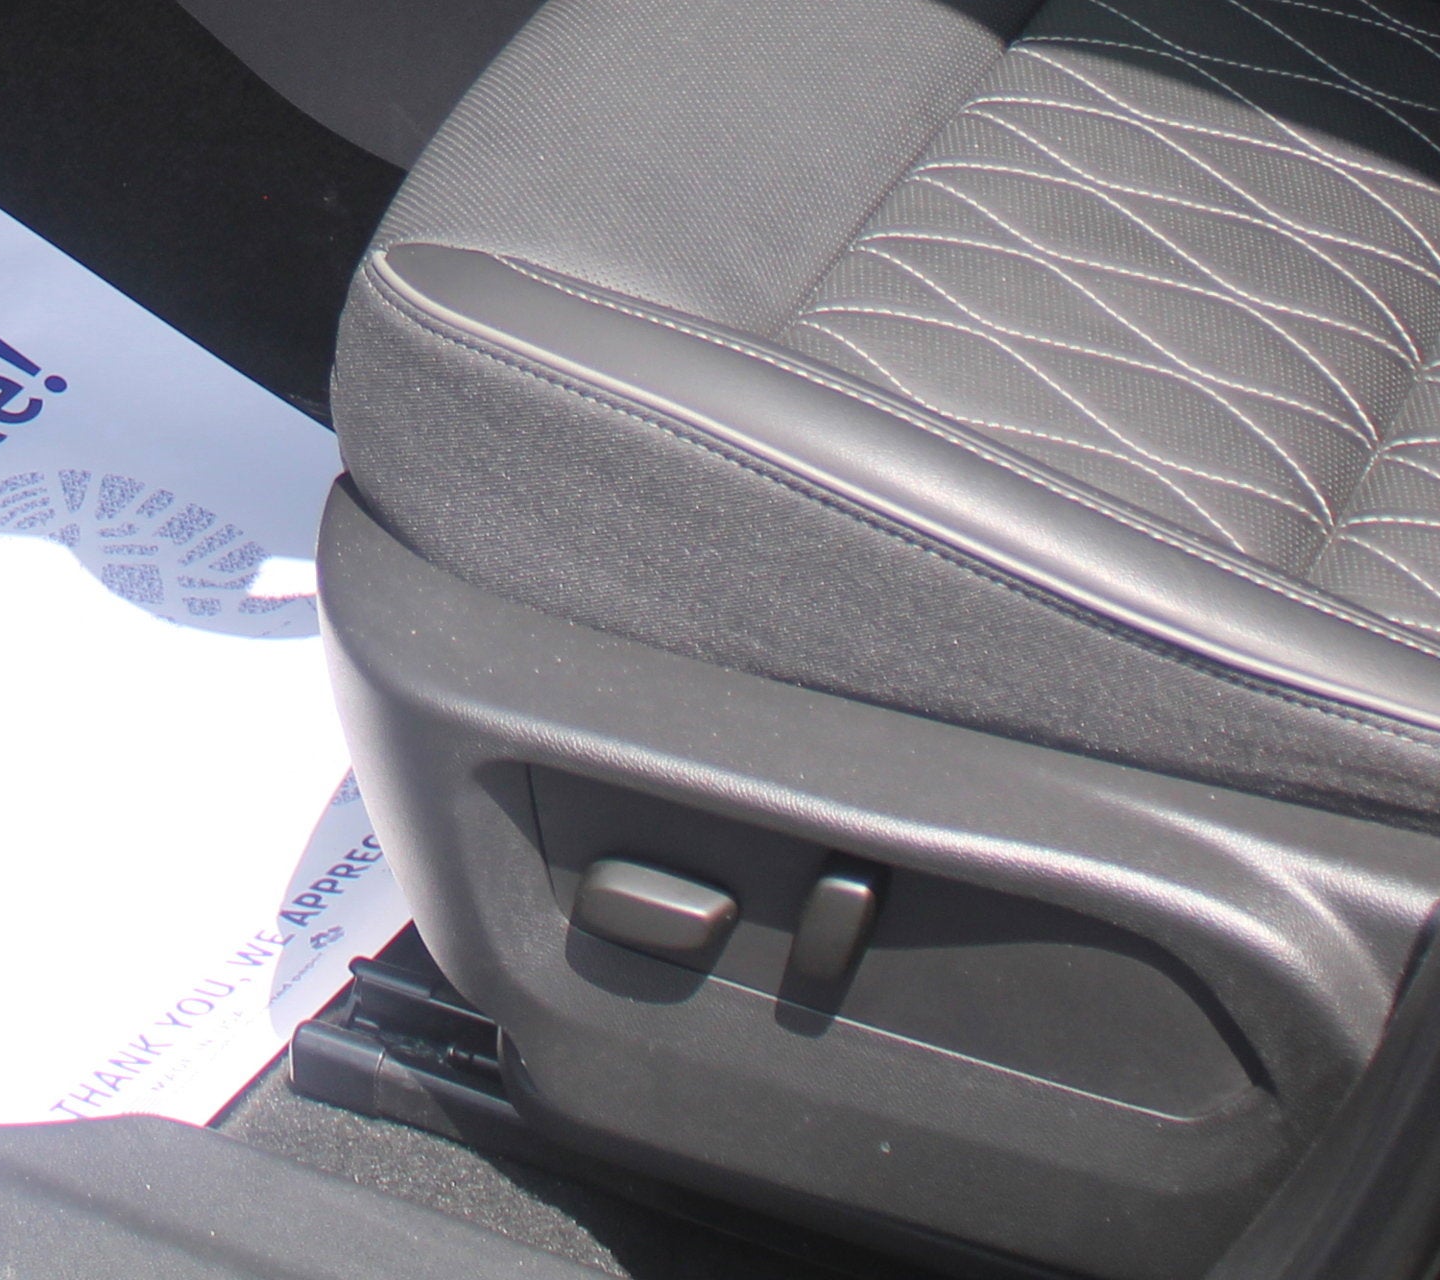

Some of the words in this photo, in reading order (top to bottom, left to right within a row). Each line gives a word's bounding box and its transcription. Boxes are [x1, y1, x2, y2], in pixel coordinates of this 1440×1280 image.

[48, 1033, 173, 1120] THANK
[225, 929, 296, 969] WE
[277, 833, 385, 929] APPREC
